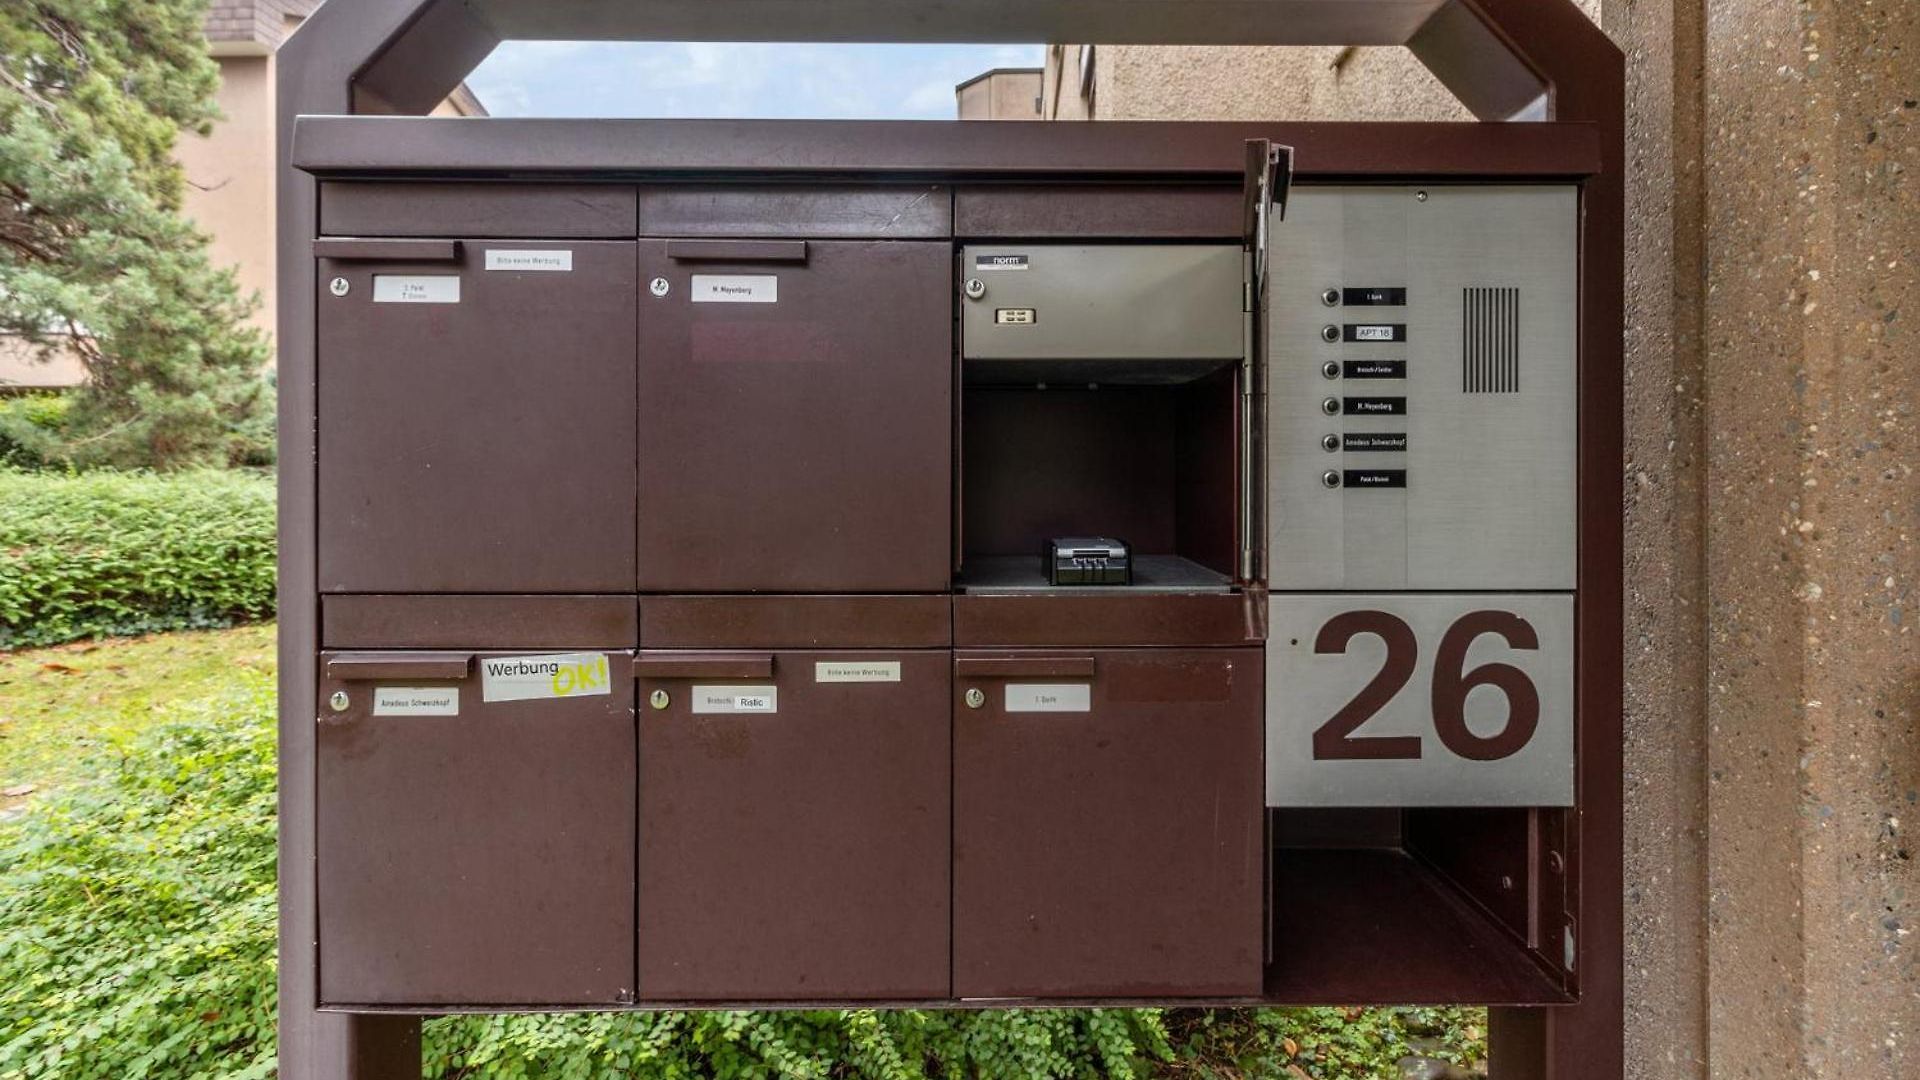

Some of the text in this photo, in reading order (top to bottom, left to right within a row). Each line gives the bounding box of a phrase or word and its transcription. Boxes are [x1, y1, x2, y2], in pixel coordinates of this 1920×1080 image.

[1360, 329, 1378, 337] APT
[487, 660, 560, 677] Werbung
[552, 655, 606, 697] OK!
[1312, 609, 1540, 761] 26
